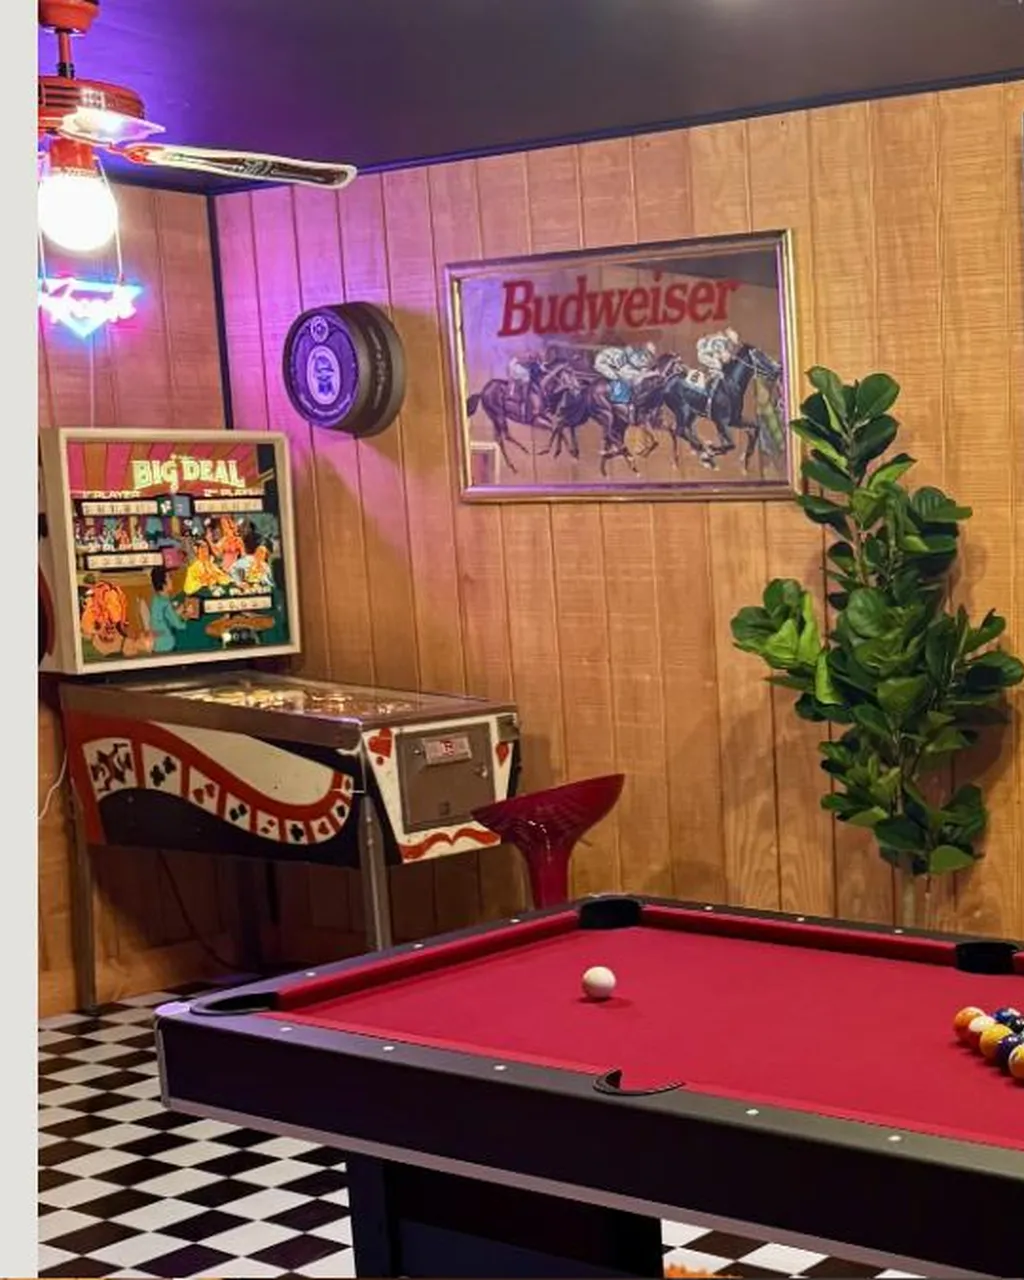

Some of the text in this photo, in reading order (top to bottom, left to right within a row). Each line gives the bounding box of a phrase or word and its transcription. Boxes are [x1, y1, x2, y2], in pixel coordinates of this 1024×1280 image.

[498, 270, 740, 338] Budweiser
[130, 454, 246, 494] BIG DEAL
